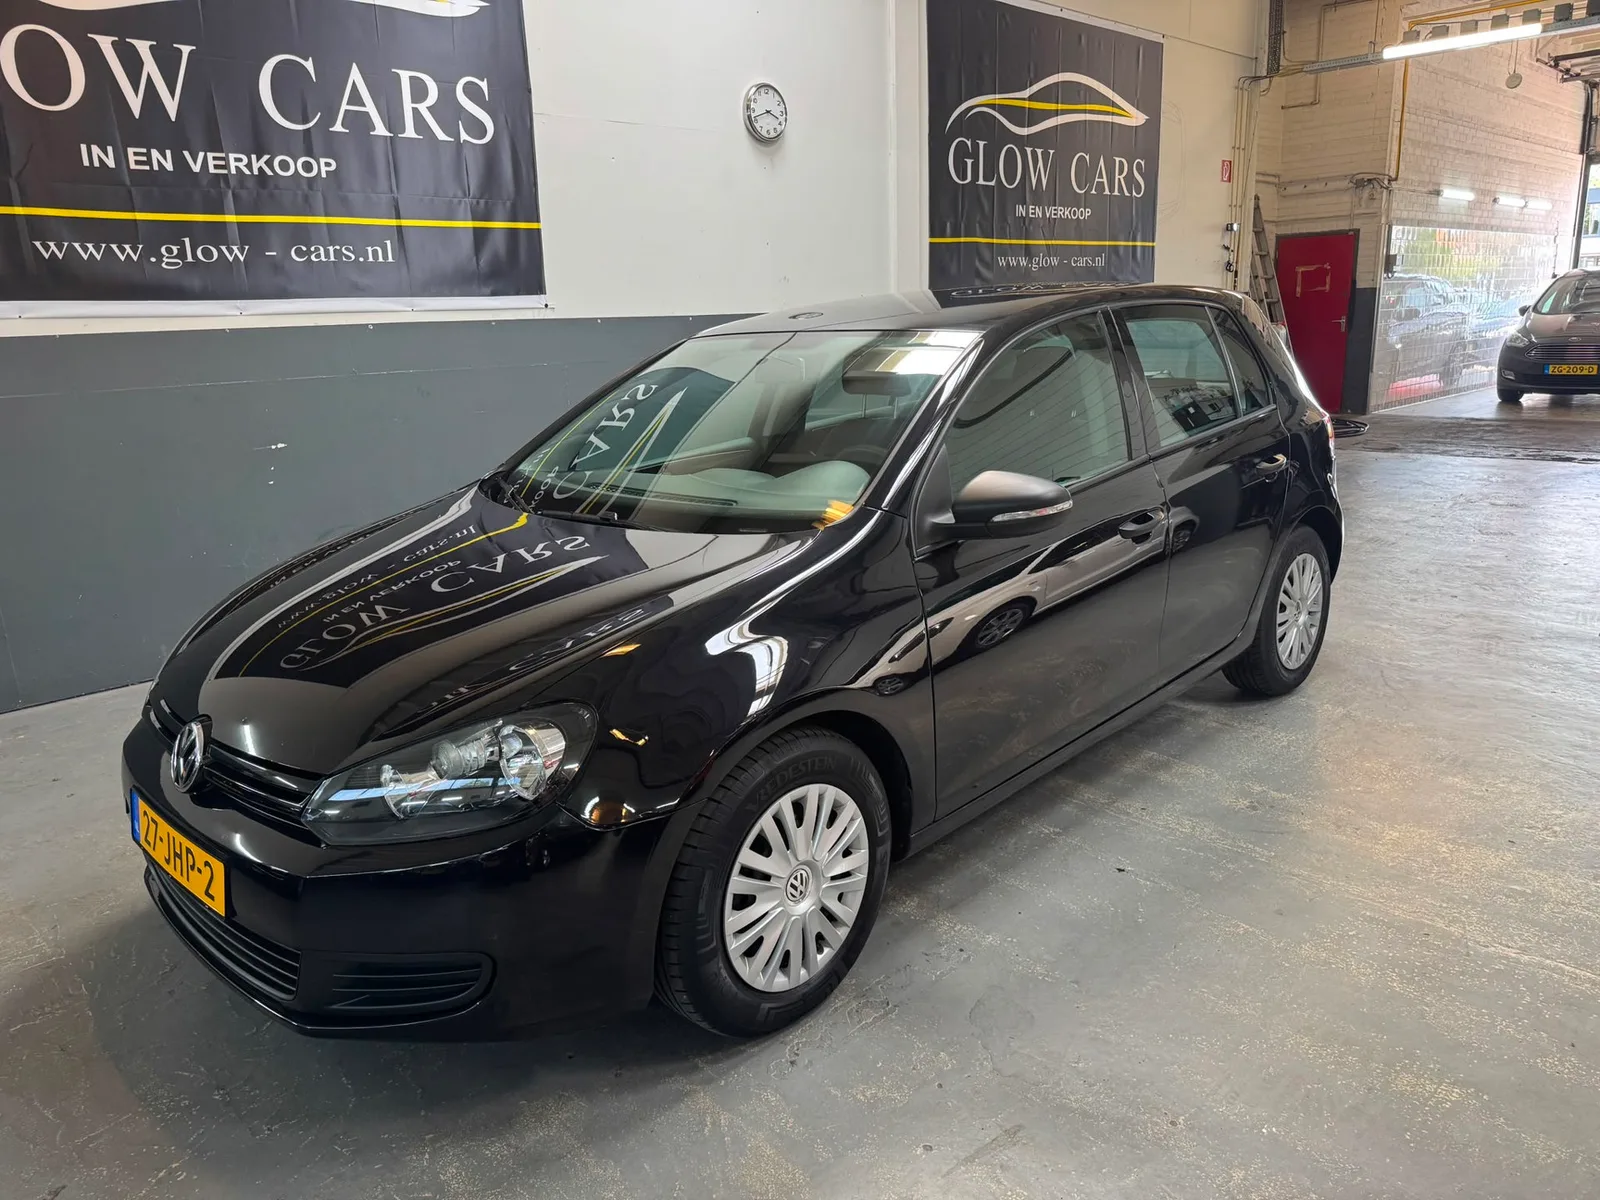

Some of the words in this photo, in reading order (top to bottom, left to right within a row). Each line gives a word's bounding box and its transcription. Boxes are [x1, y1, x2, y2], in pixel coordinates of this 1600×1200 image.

[258, 54, 495, 145] CARS
[80, 143, 116, 169] IN
[126, 147, 174, 172] EN
[182, 150, 338, 178] VERKOOP
[948, 137, 1055, 192] GLOW
[1070, 152, 1146, 198] CARS
[1015, 204, 1026, 217] IN
[1029, 205, 1043, 218] EN
[1044, 206, 1092, 220] VERKOOP
[33, 237, 250, 270] www.glow
[290, 239, 396, 264] cars.nl
[997, 252, 1060, 271] www.glow
[1071, 253, 1105, 267] cars.nl
[1551, 365, 1594, 374] ZG-209-D
[142, 809, 216, 902] 27-JHP-2
